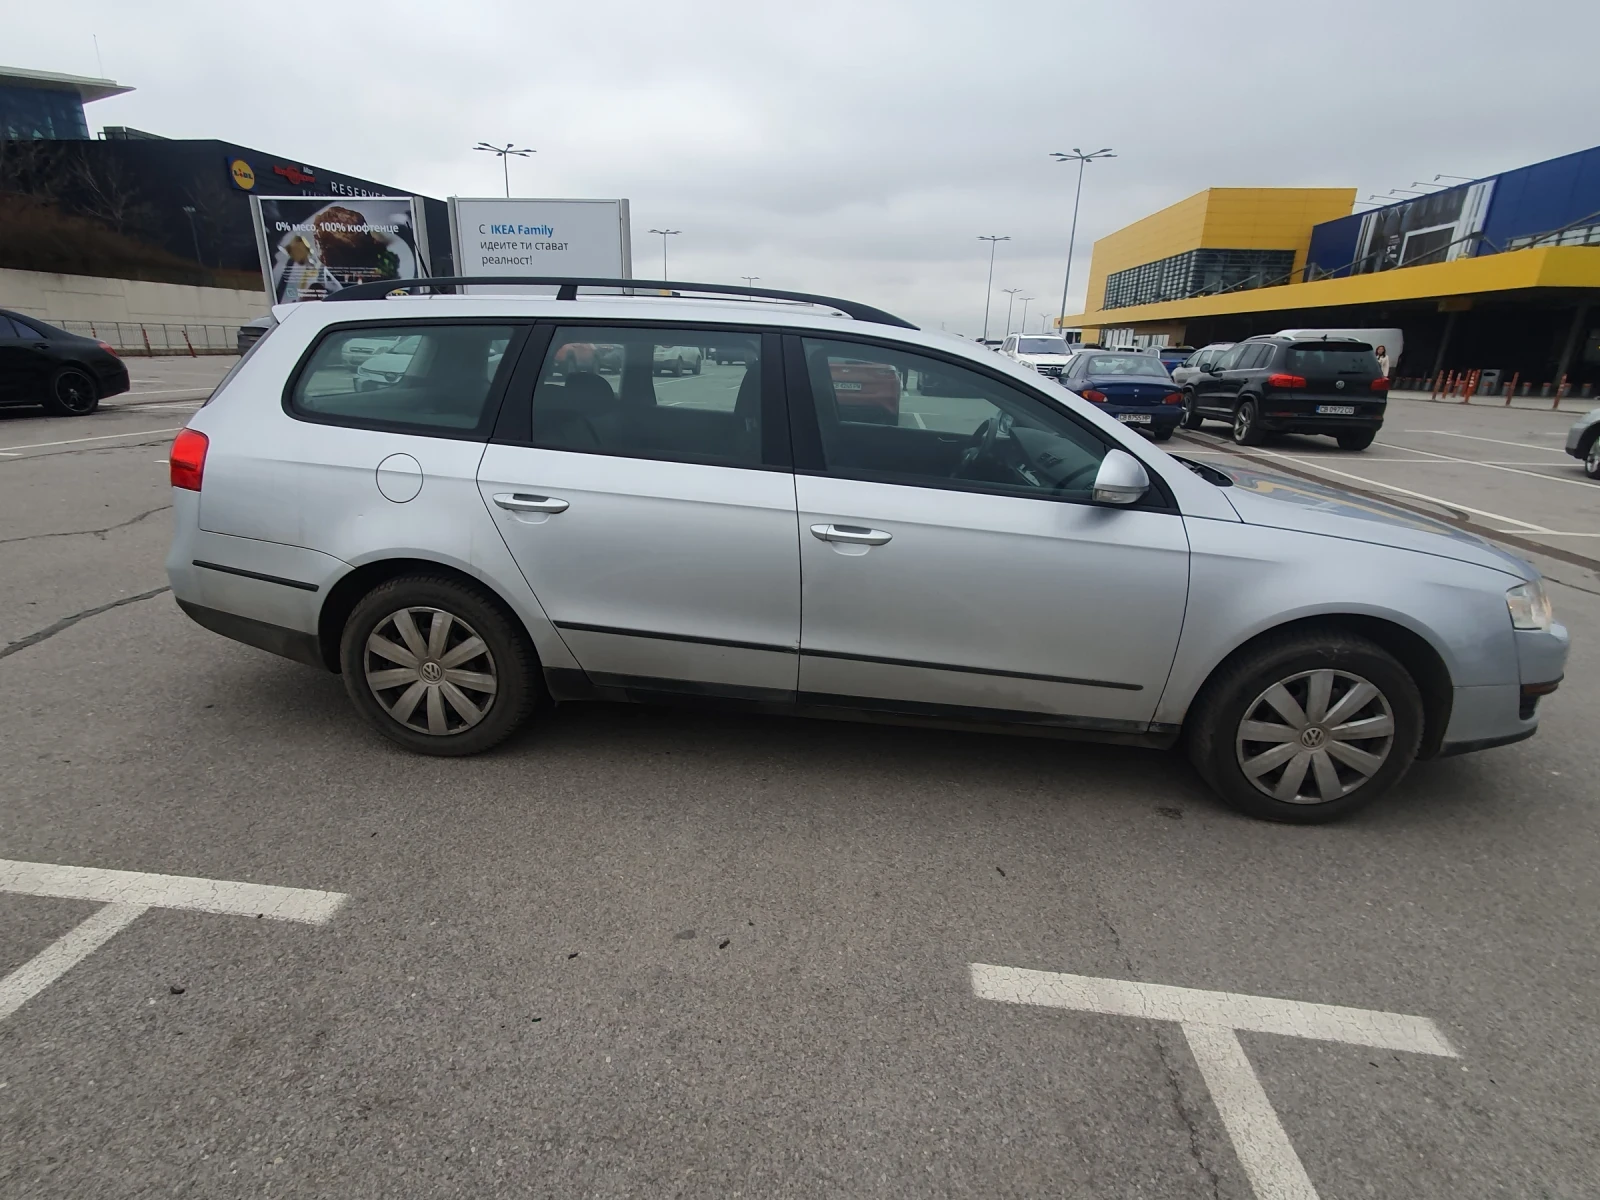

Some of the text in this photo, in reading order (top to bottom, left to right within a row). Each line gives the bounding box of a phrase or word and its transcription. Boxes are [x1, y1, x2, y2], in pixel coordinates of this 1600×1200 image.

[331, 181, 387, 198] RESERV
[275, 221, 399, 235] 0% месо, 100% кюфтенце
[490, 224, 516, 235] IKEA
[517, 224, 554, 239] Family
[480, 241, 569, 251] идеите ти стават
[481, 255, 533, 267] реалност!
